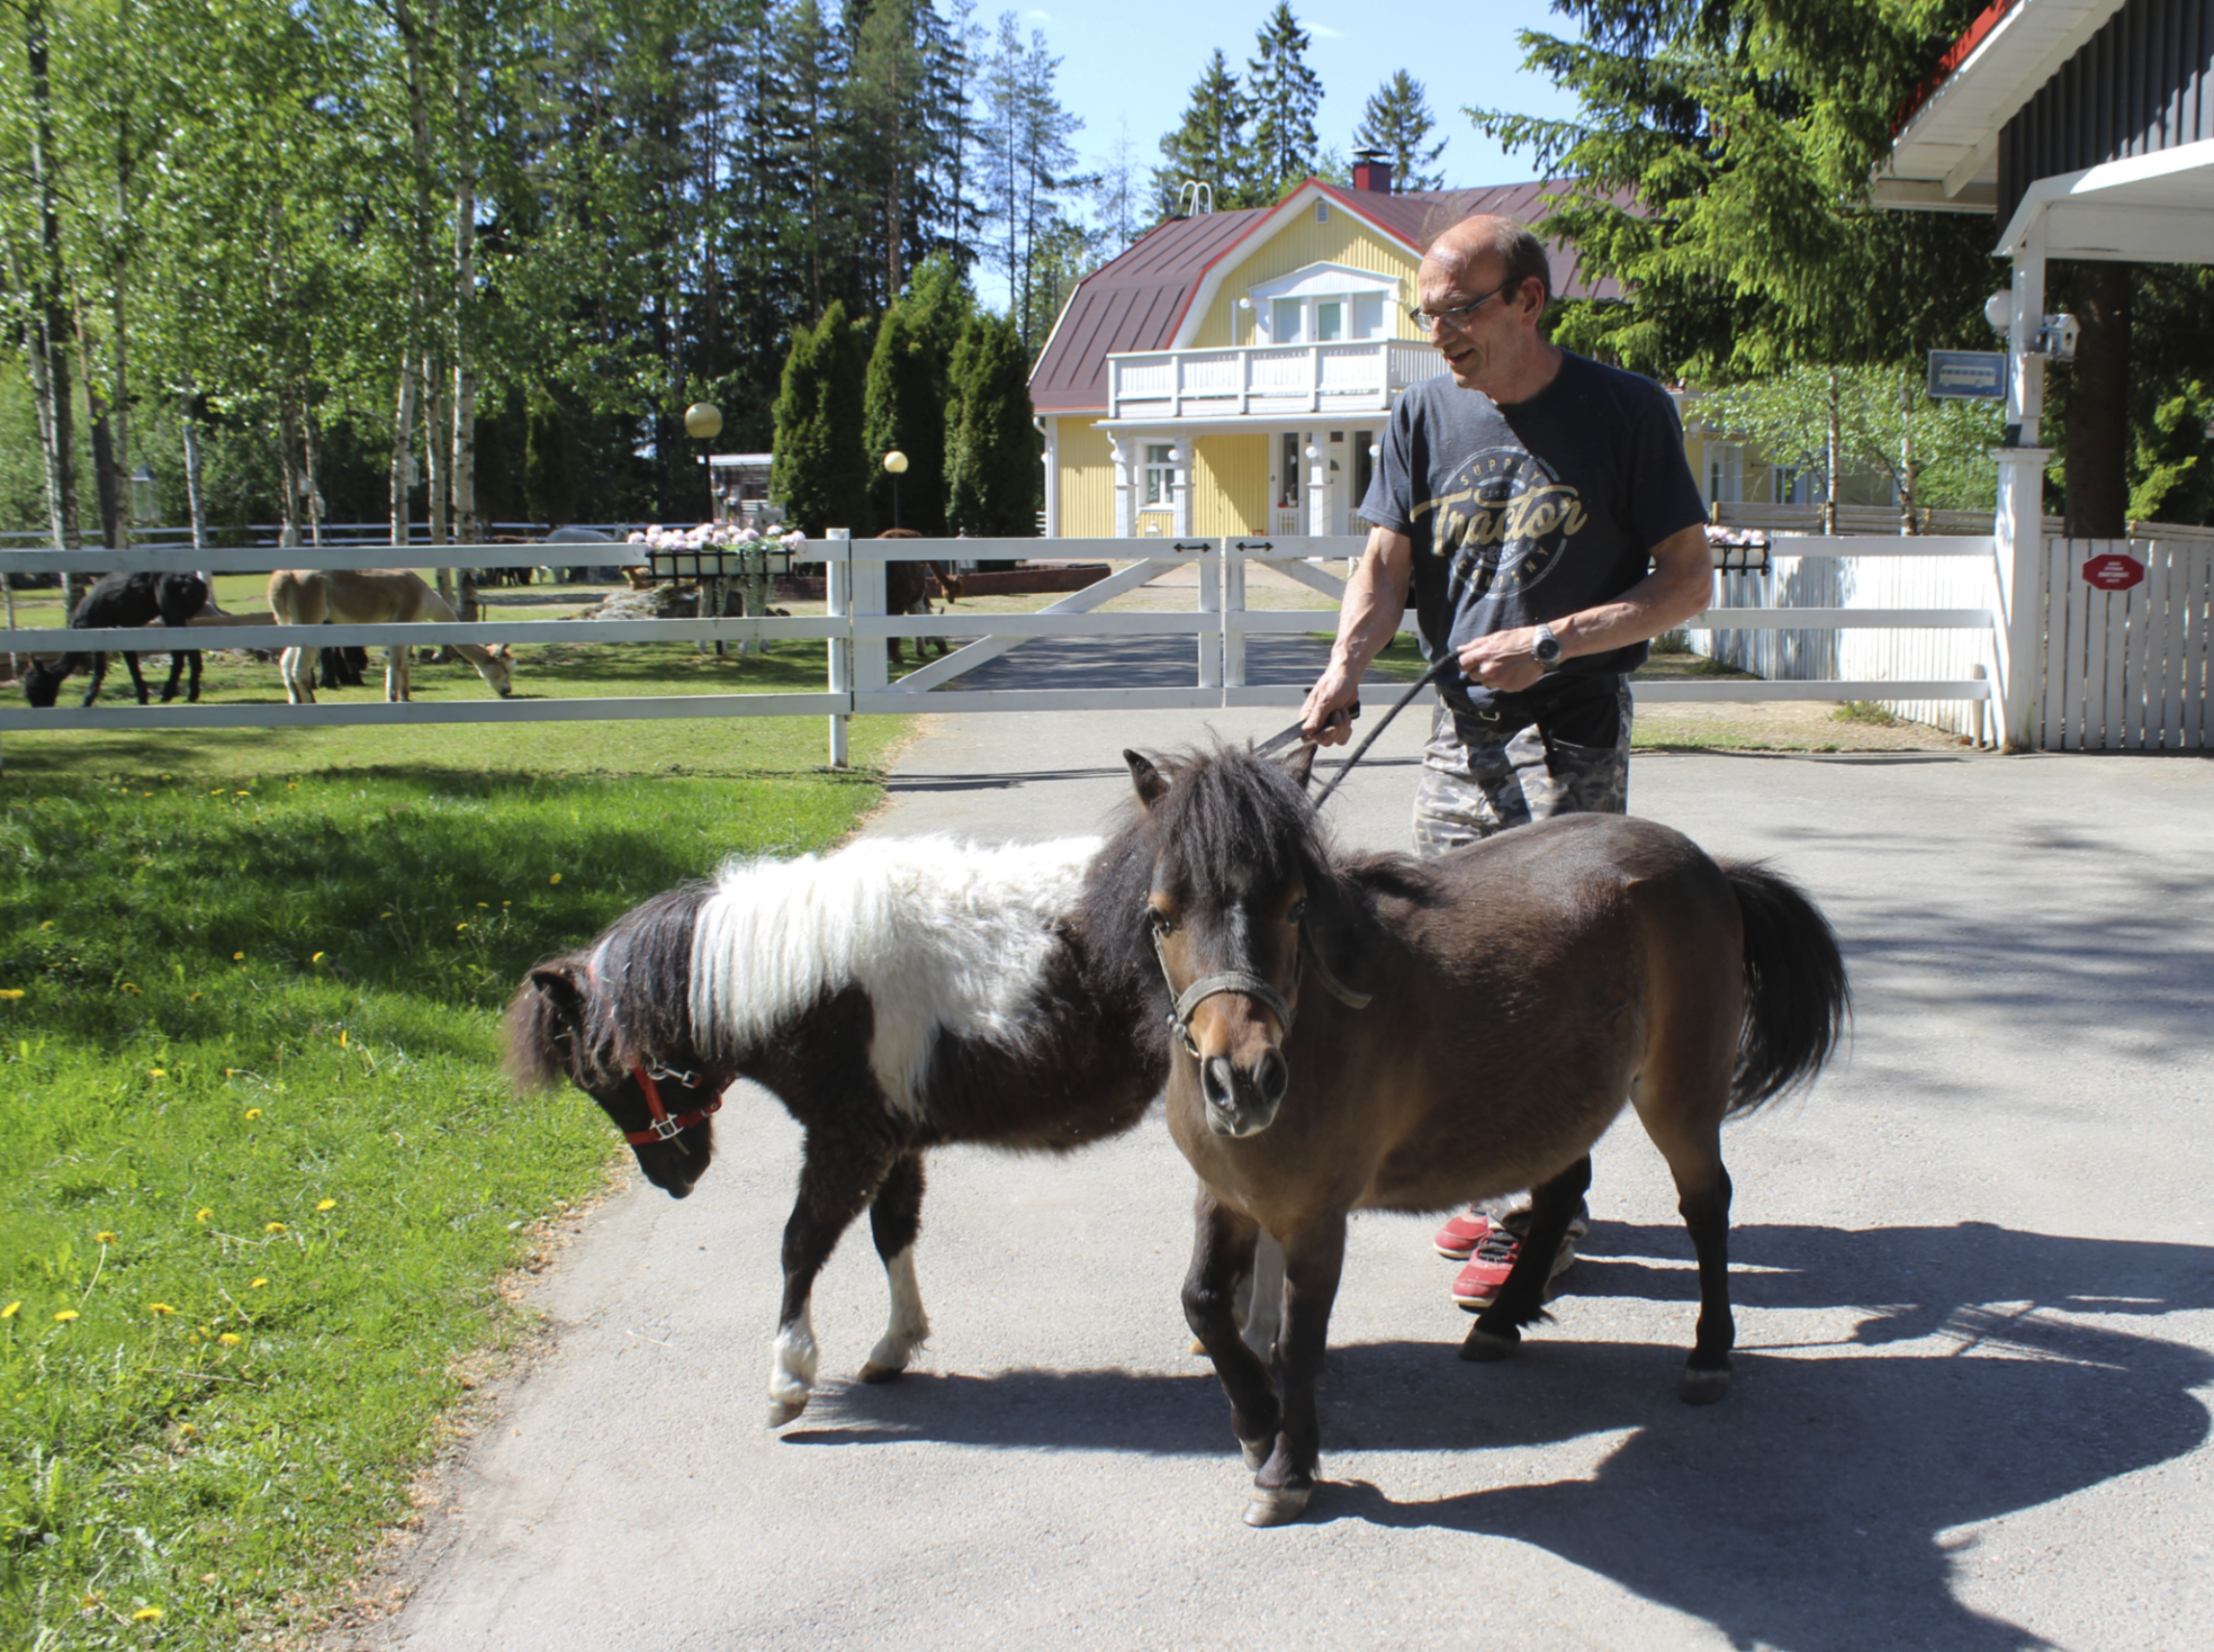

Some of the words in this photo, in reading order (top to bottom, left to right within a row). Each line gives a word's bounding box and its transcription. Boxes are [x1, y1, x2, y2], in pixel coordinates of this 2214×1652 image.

[1459, 457, 1541, 486] SUPPLY
[1409, 484, 1588, 556] Tractor
[1457, 546, 1549, 588] COMPANY
